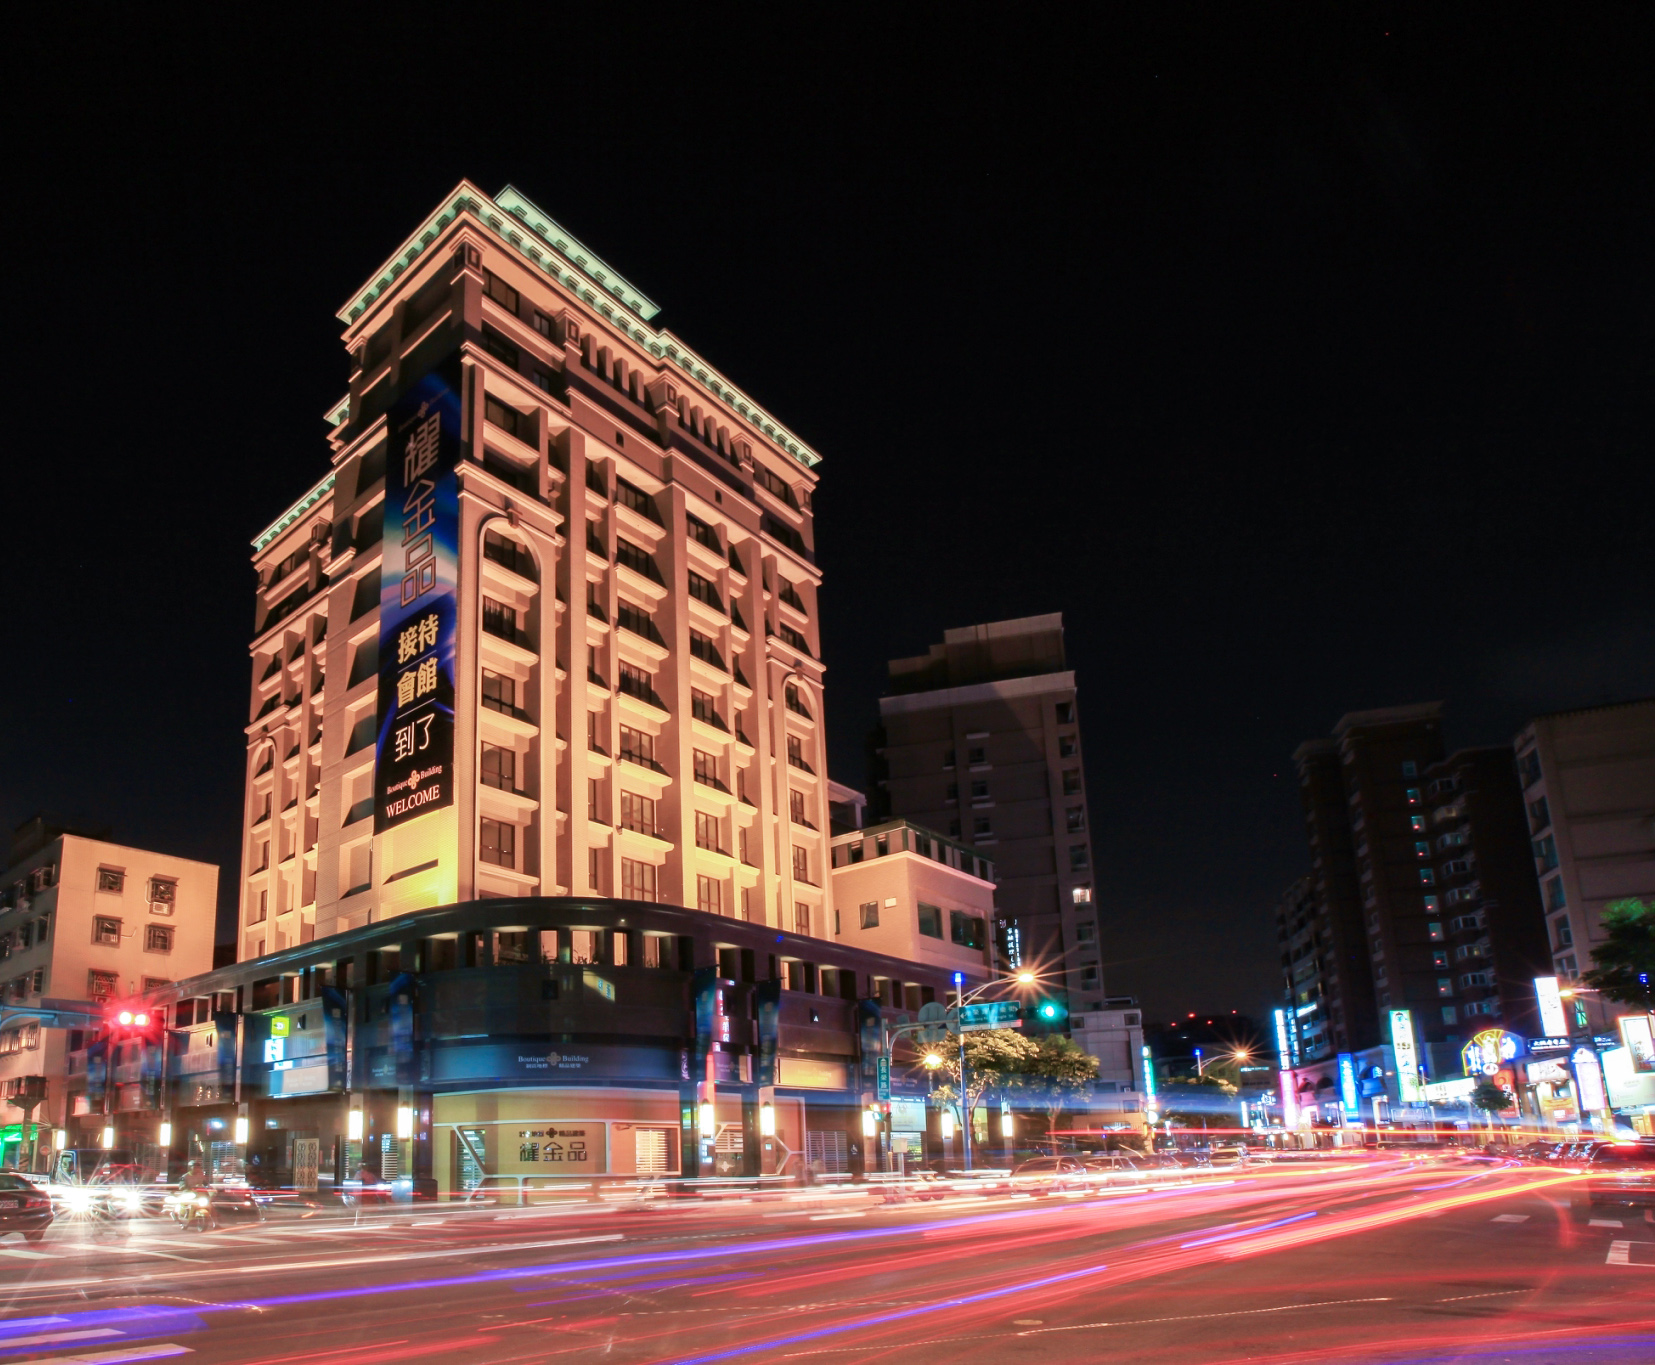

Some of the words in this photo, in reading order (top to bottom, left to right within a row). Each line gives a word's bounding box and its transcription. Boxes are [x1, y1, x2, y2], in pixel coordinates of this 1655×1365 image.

[397, 613, 439, 665] 接待
[397, 657, 438, 709] 會館
[394, 713, 435, 762] 到了
[386, 780, 408, 795] Boutique
[420, 765, 443, 780] Building
[386, 784, 440, 818] WELCOME
[518, 1055, 546, 1063] Boutique
[562, 1055, 589, 1063] Building
